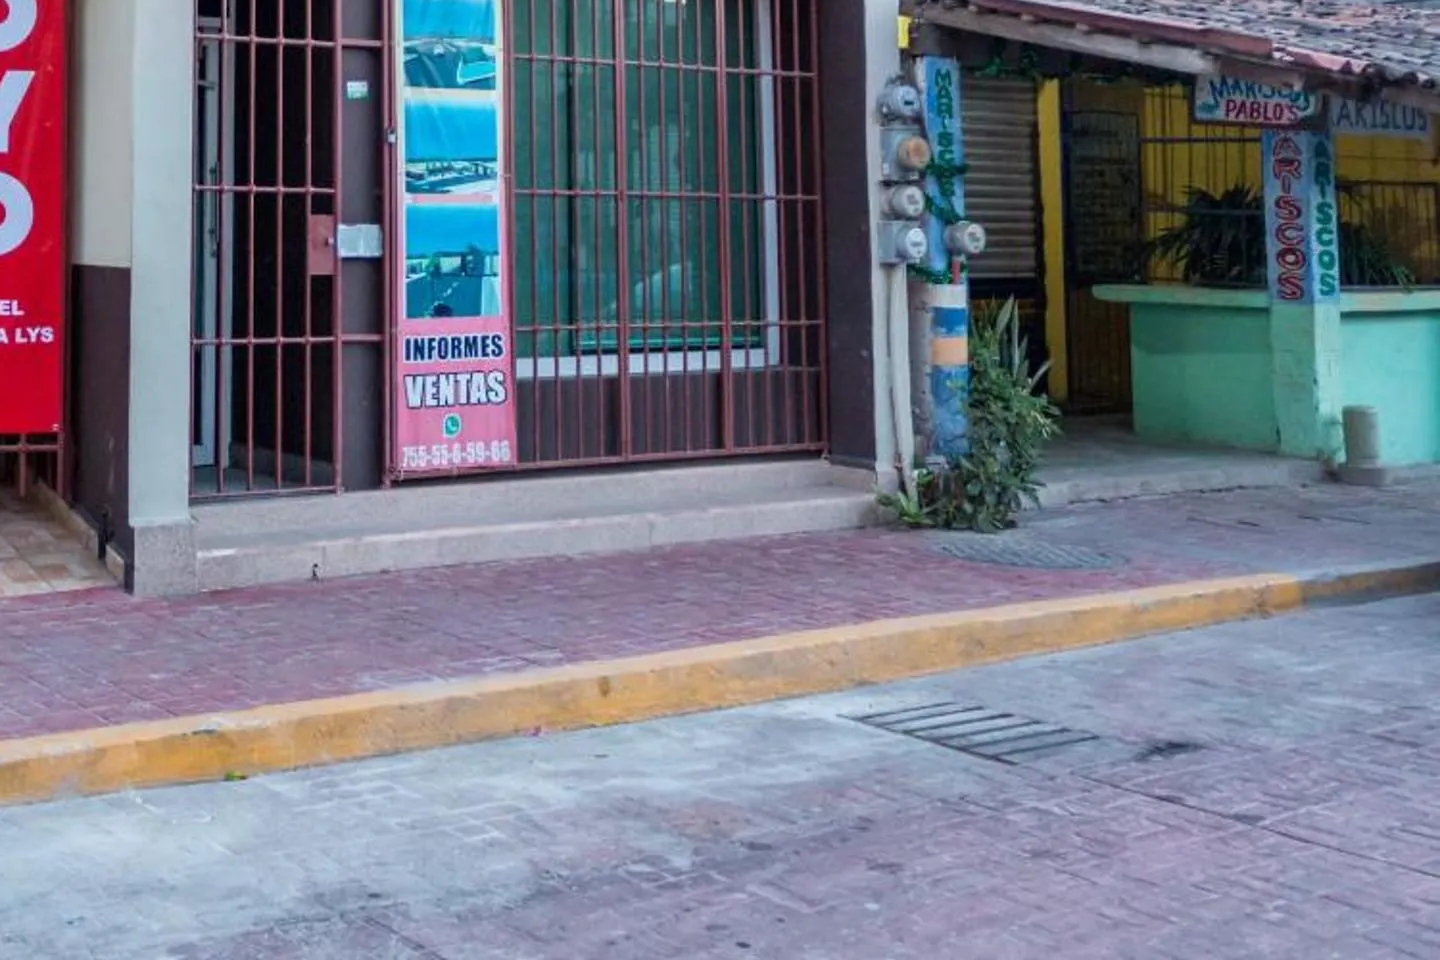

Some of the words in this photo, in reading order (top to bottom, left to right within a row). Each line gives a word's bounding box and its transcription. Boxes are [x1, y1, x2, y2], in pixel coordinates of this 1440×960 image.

[933, 67, 955, 197] MARISCS
[14, 326, 55, 344] LYS
[404, 333, 504, 362] INFORMES
[403, 370, 508, 409] VENTAS
